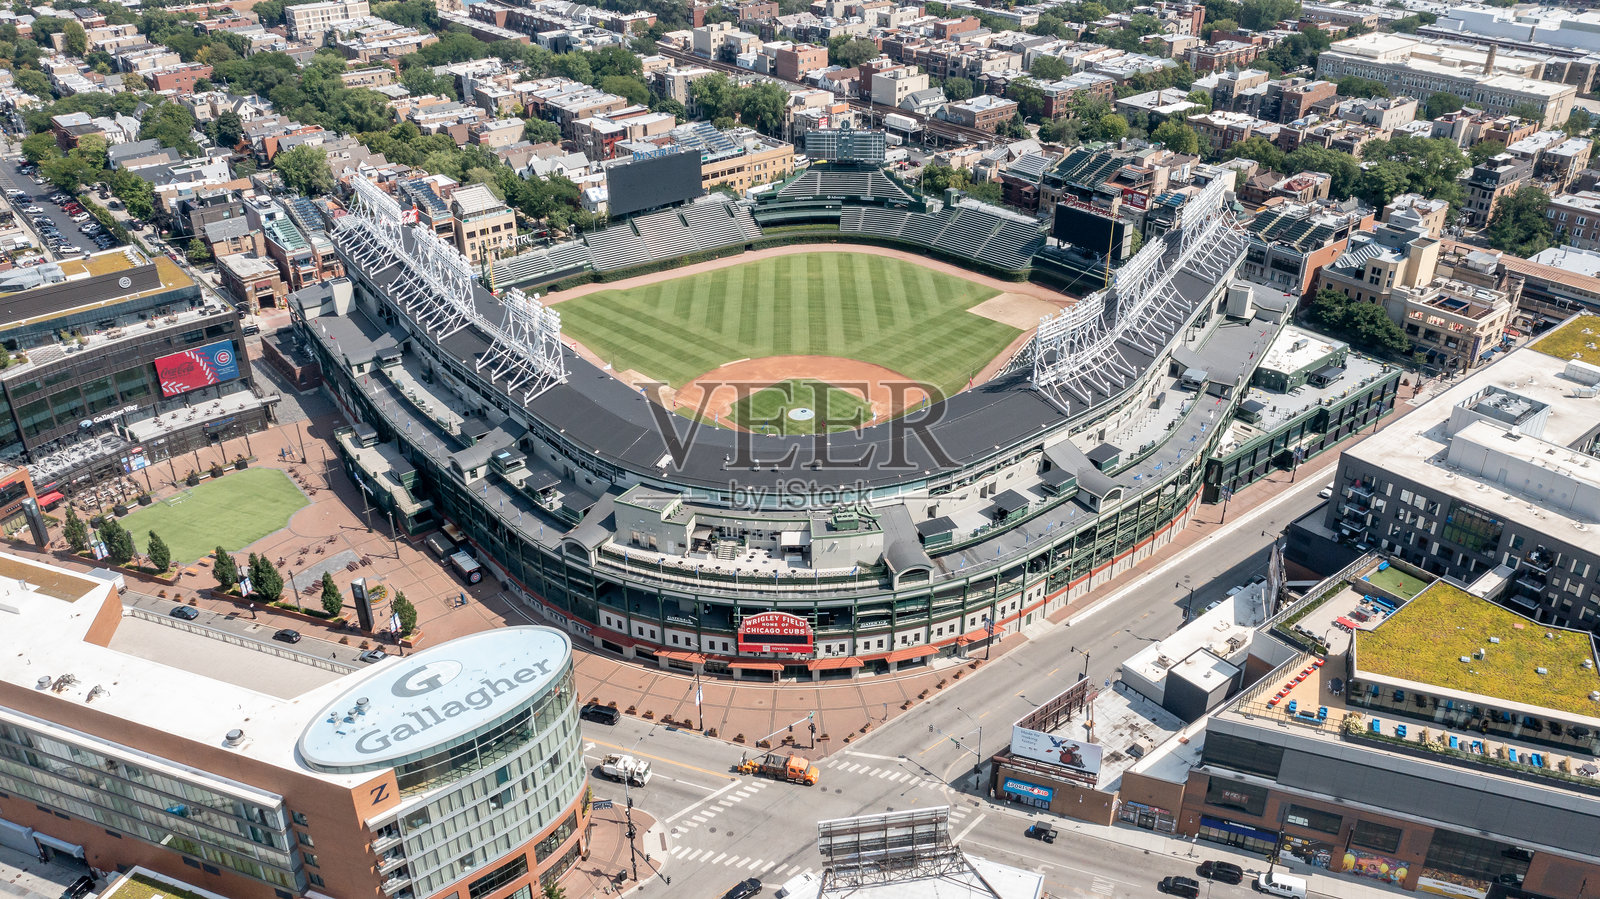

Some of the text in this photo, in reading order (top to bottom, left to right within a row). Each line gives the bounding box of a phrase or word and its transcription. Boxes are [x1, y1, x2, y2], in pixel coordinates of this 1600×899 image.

[94, 404, 138, 423] Gallagher Way
[746, 615, 805, 627] WRIGLEY FIELD
[355, 658, 552, 754] Gallagher
[371, 783, 389, 806] Z
